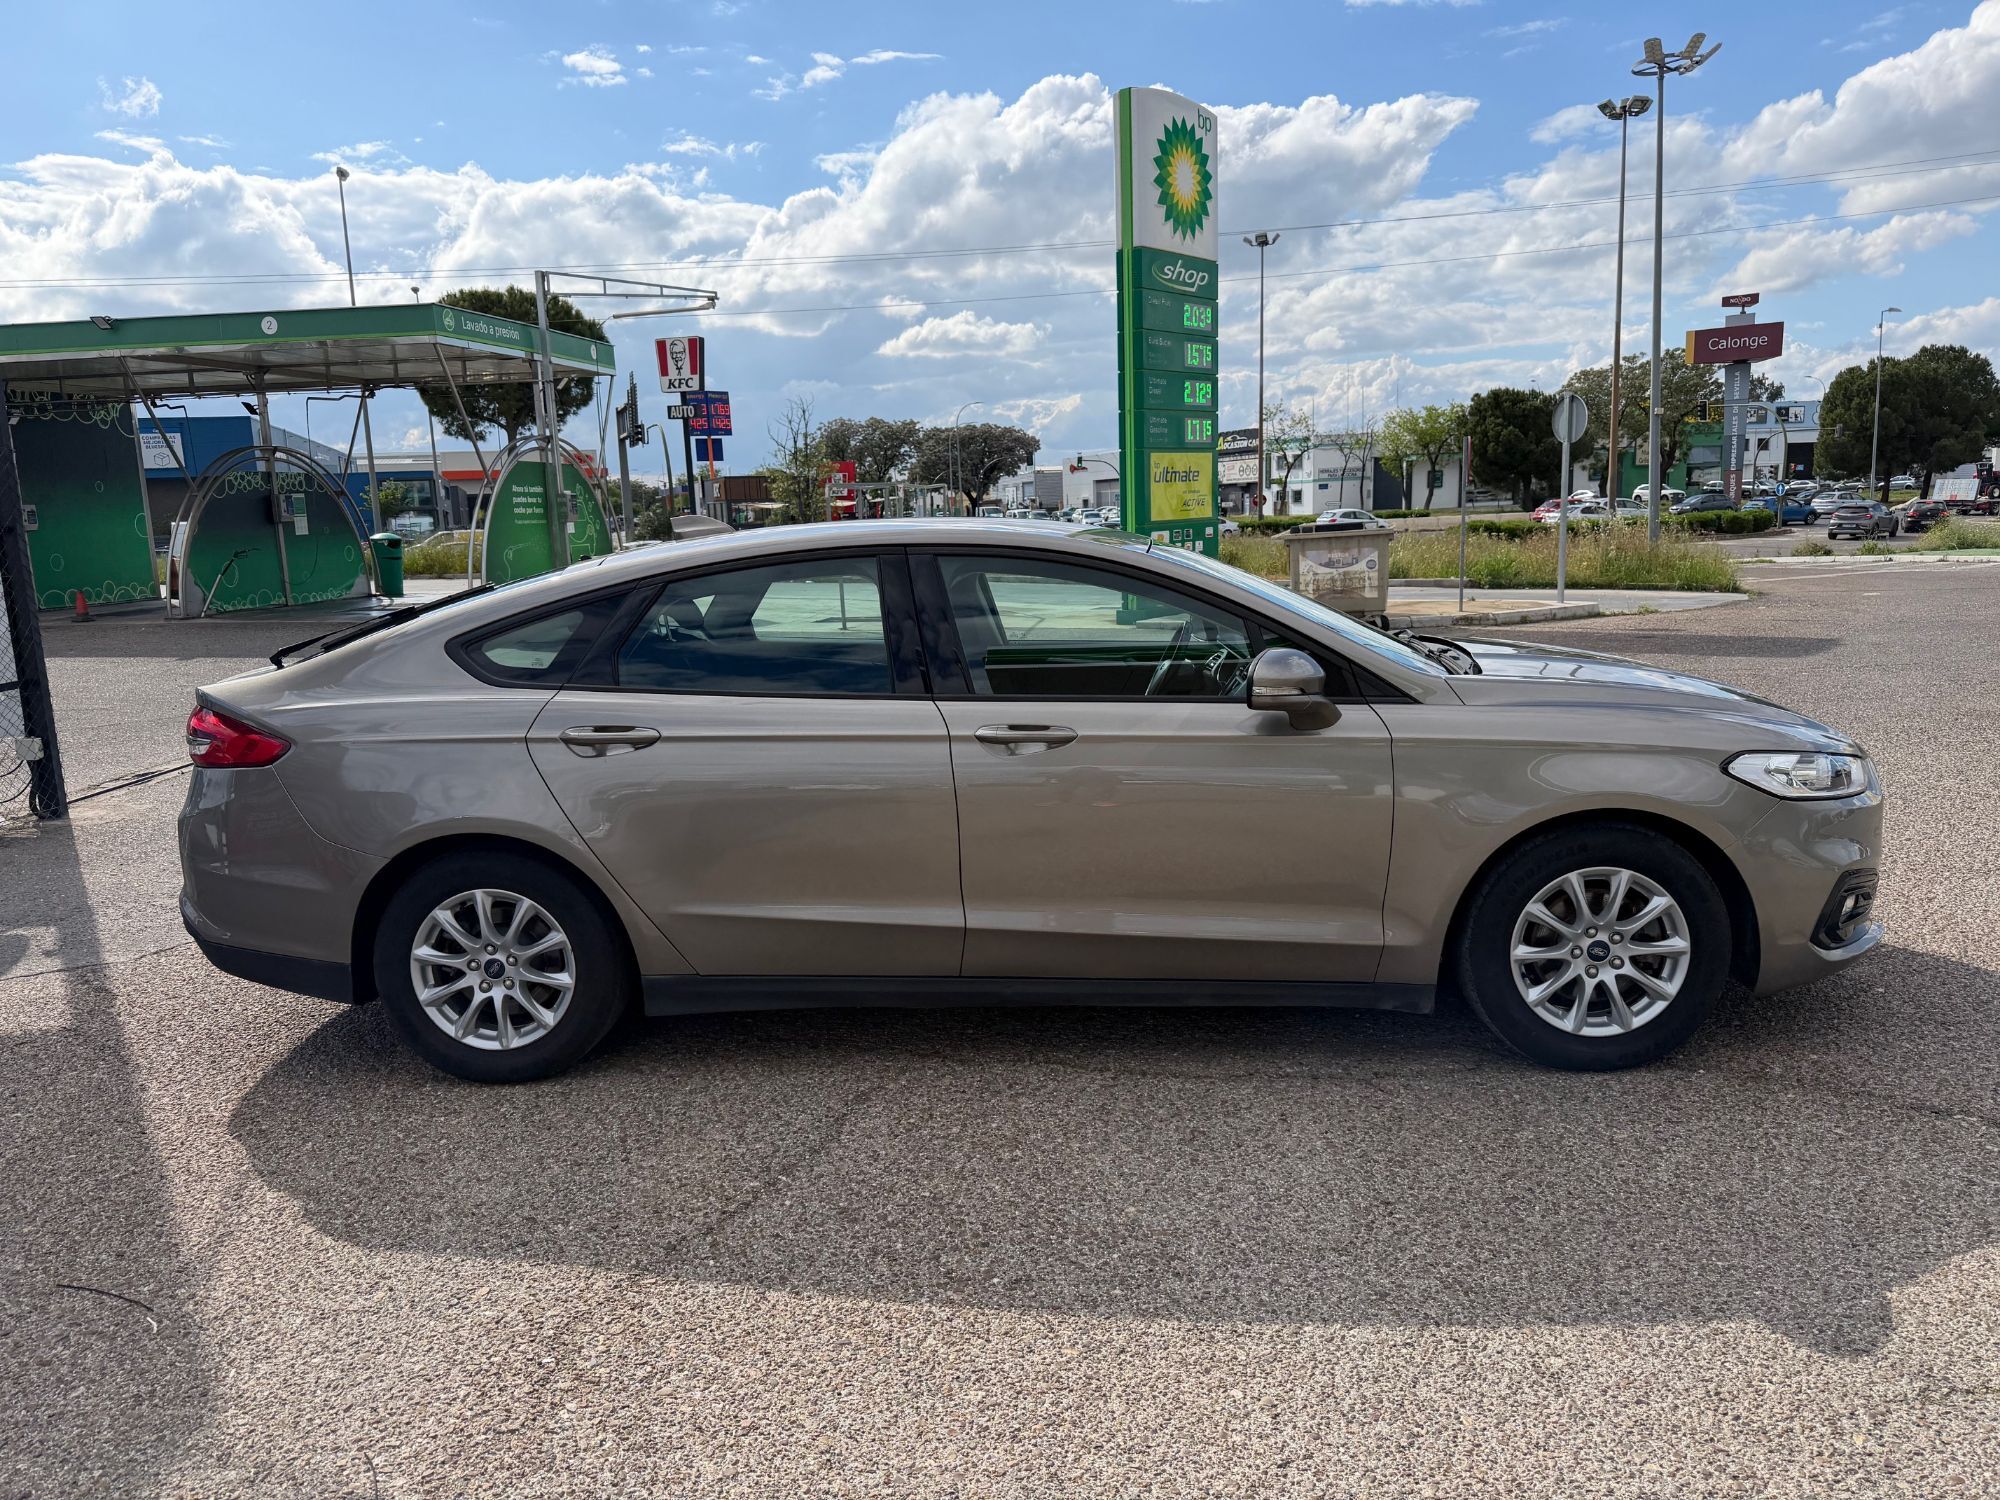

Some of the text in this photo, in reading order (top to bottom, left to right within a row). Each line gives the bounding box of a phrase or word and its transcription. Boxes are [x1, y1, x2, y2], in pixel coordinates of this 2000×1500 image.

[1197, 108, 1212, 136] bp
[1162, 260, 1209, 291] shop
[266, 320, 273, 330] 2
[461, 316, 520, 341] Lavado a presión
[1708, 333, 1768, 350] Calonge
[667, 377, 693, 390] KFC
[670, 405, 695, 419] AUTO
[1154, 466, 1200, 483] ultimate
[513, 496, 527, 504] puedes
[1183, 498, 1206, 507] ACTIVE
